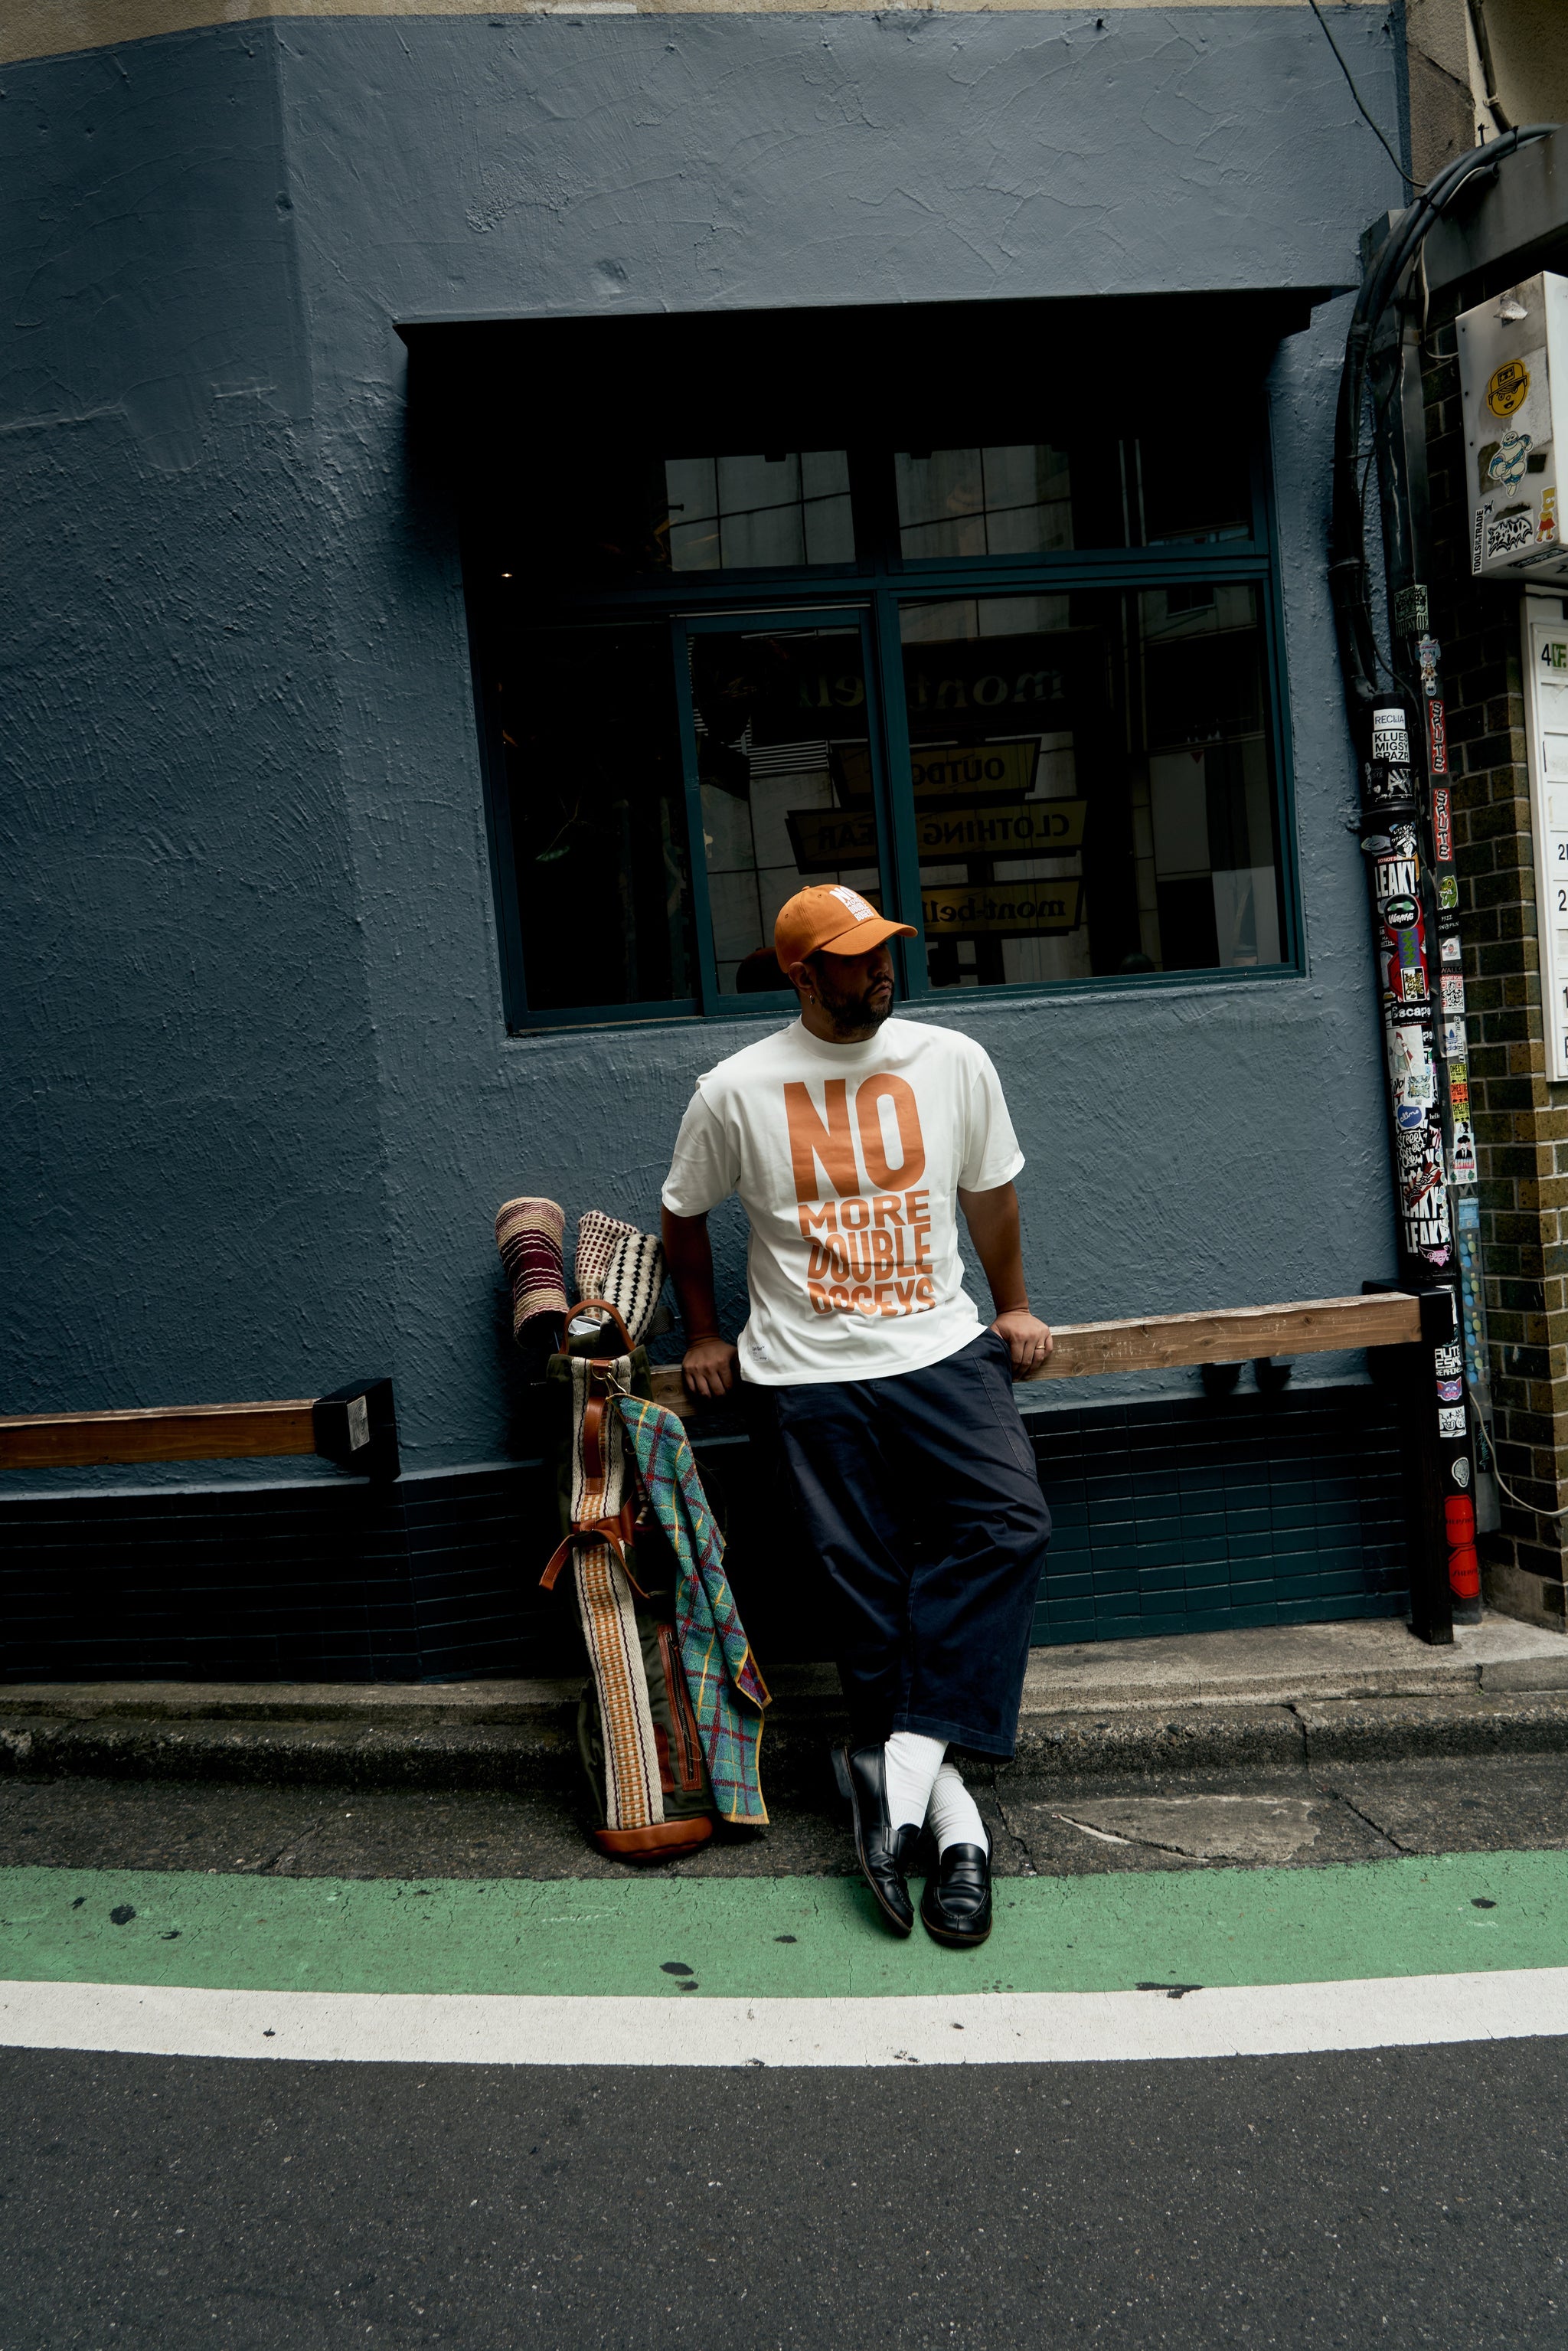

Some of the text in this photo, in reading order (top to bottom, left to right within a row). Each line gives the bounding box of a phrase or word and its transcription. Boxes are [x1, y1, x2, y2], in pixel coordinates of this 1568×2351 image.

[1475, 509, 1484, 539] TRADE
[1374, 732, 1408, 742] KLUES
[1375, 742, 1409, 753] MIGSY
[829, 886, 857, 904] NO
[1375, 861, 1416, 898] LEAKY
[783, 1073, 926, 1202] NO
[798, 1189, 931, 1236] MORE
[803, 1223, 933, 1283] DOUBLE
